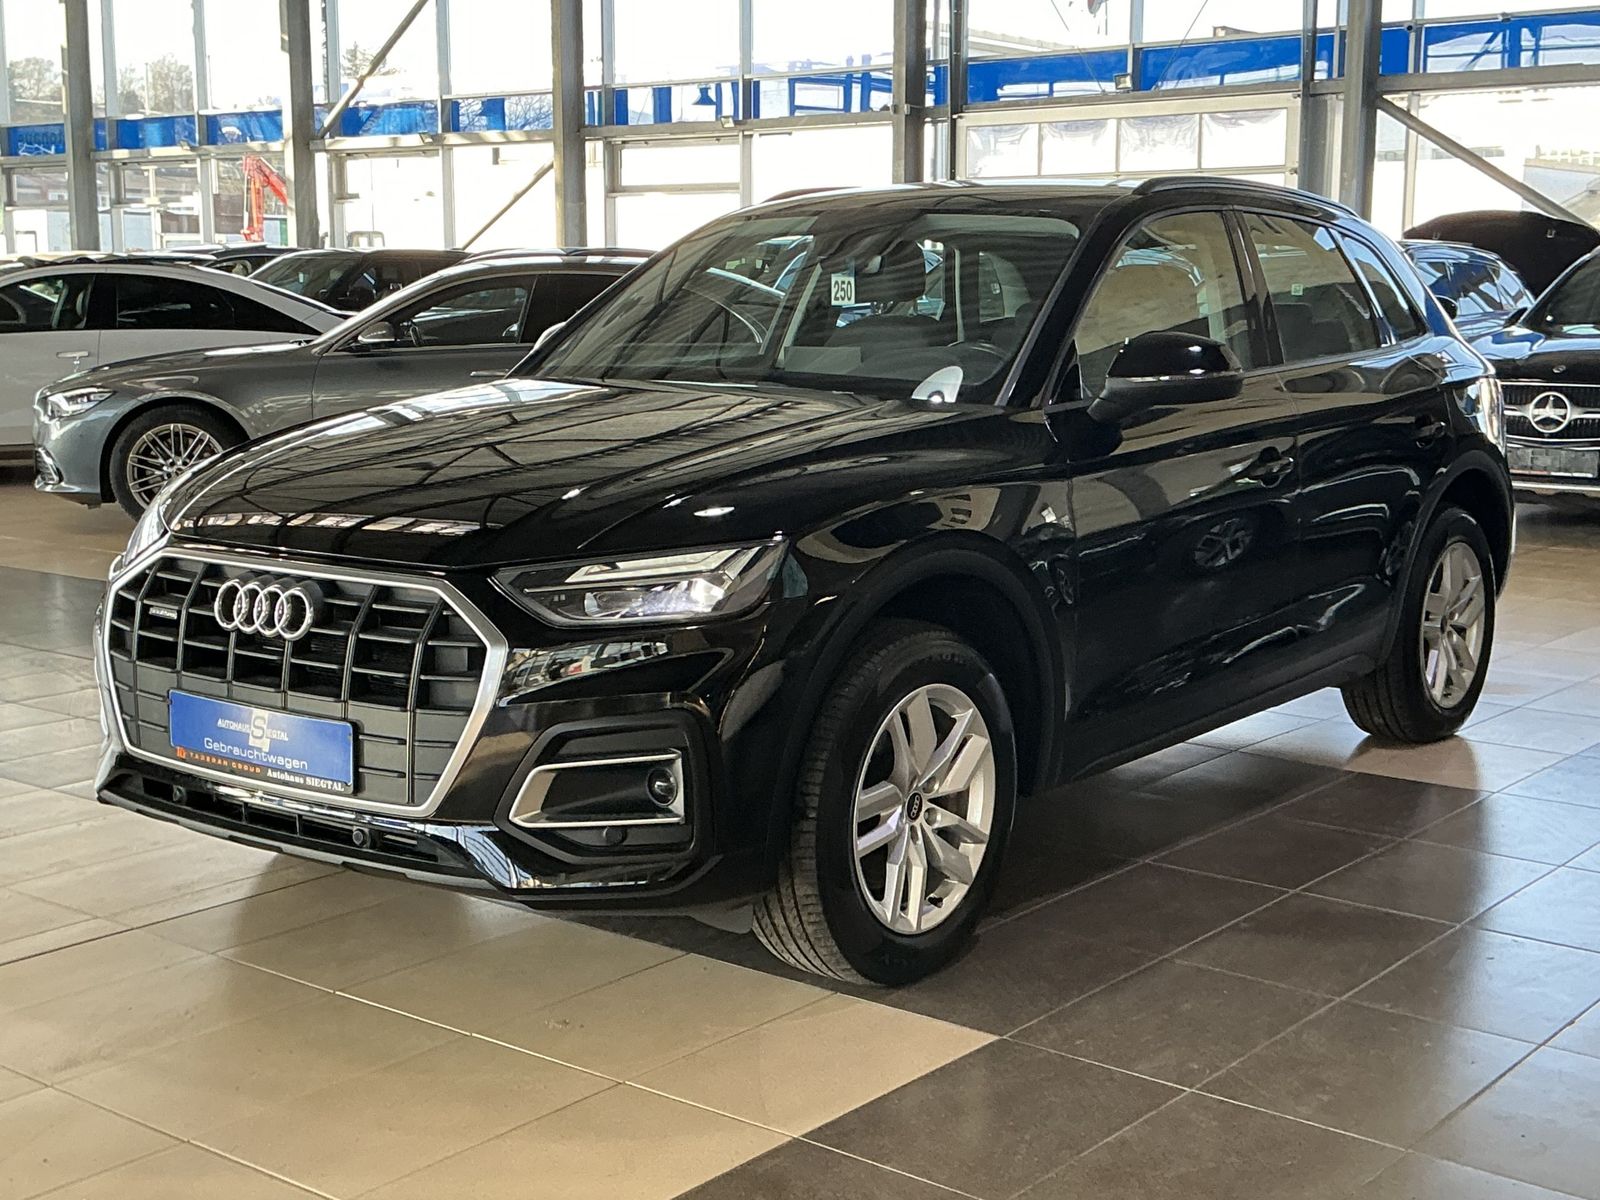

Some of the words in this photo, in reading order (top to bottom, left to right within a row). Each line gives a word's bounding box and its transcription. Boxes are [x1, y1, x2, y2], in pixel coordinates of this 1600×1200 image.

[833, 280, 853, 302] 250
[217, 718, 251, 733] AUTOHAUS
[204, 737, 308, 770] Gebrauchtwagen
[266, 767, 304, 784] Autohaus
[305, 777, 345, 792] SIEGTAL
